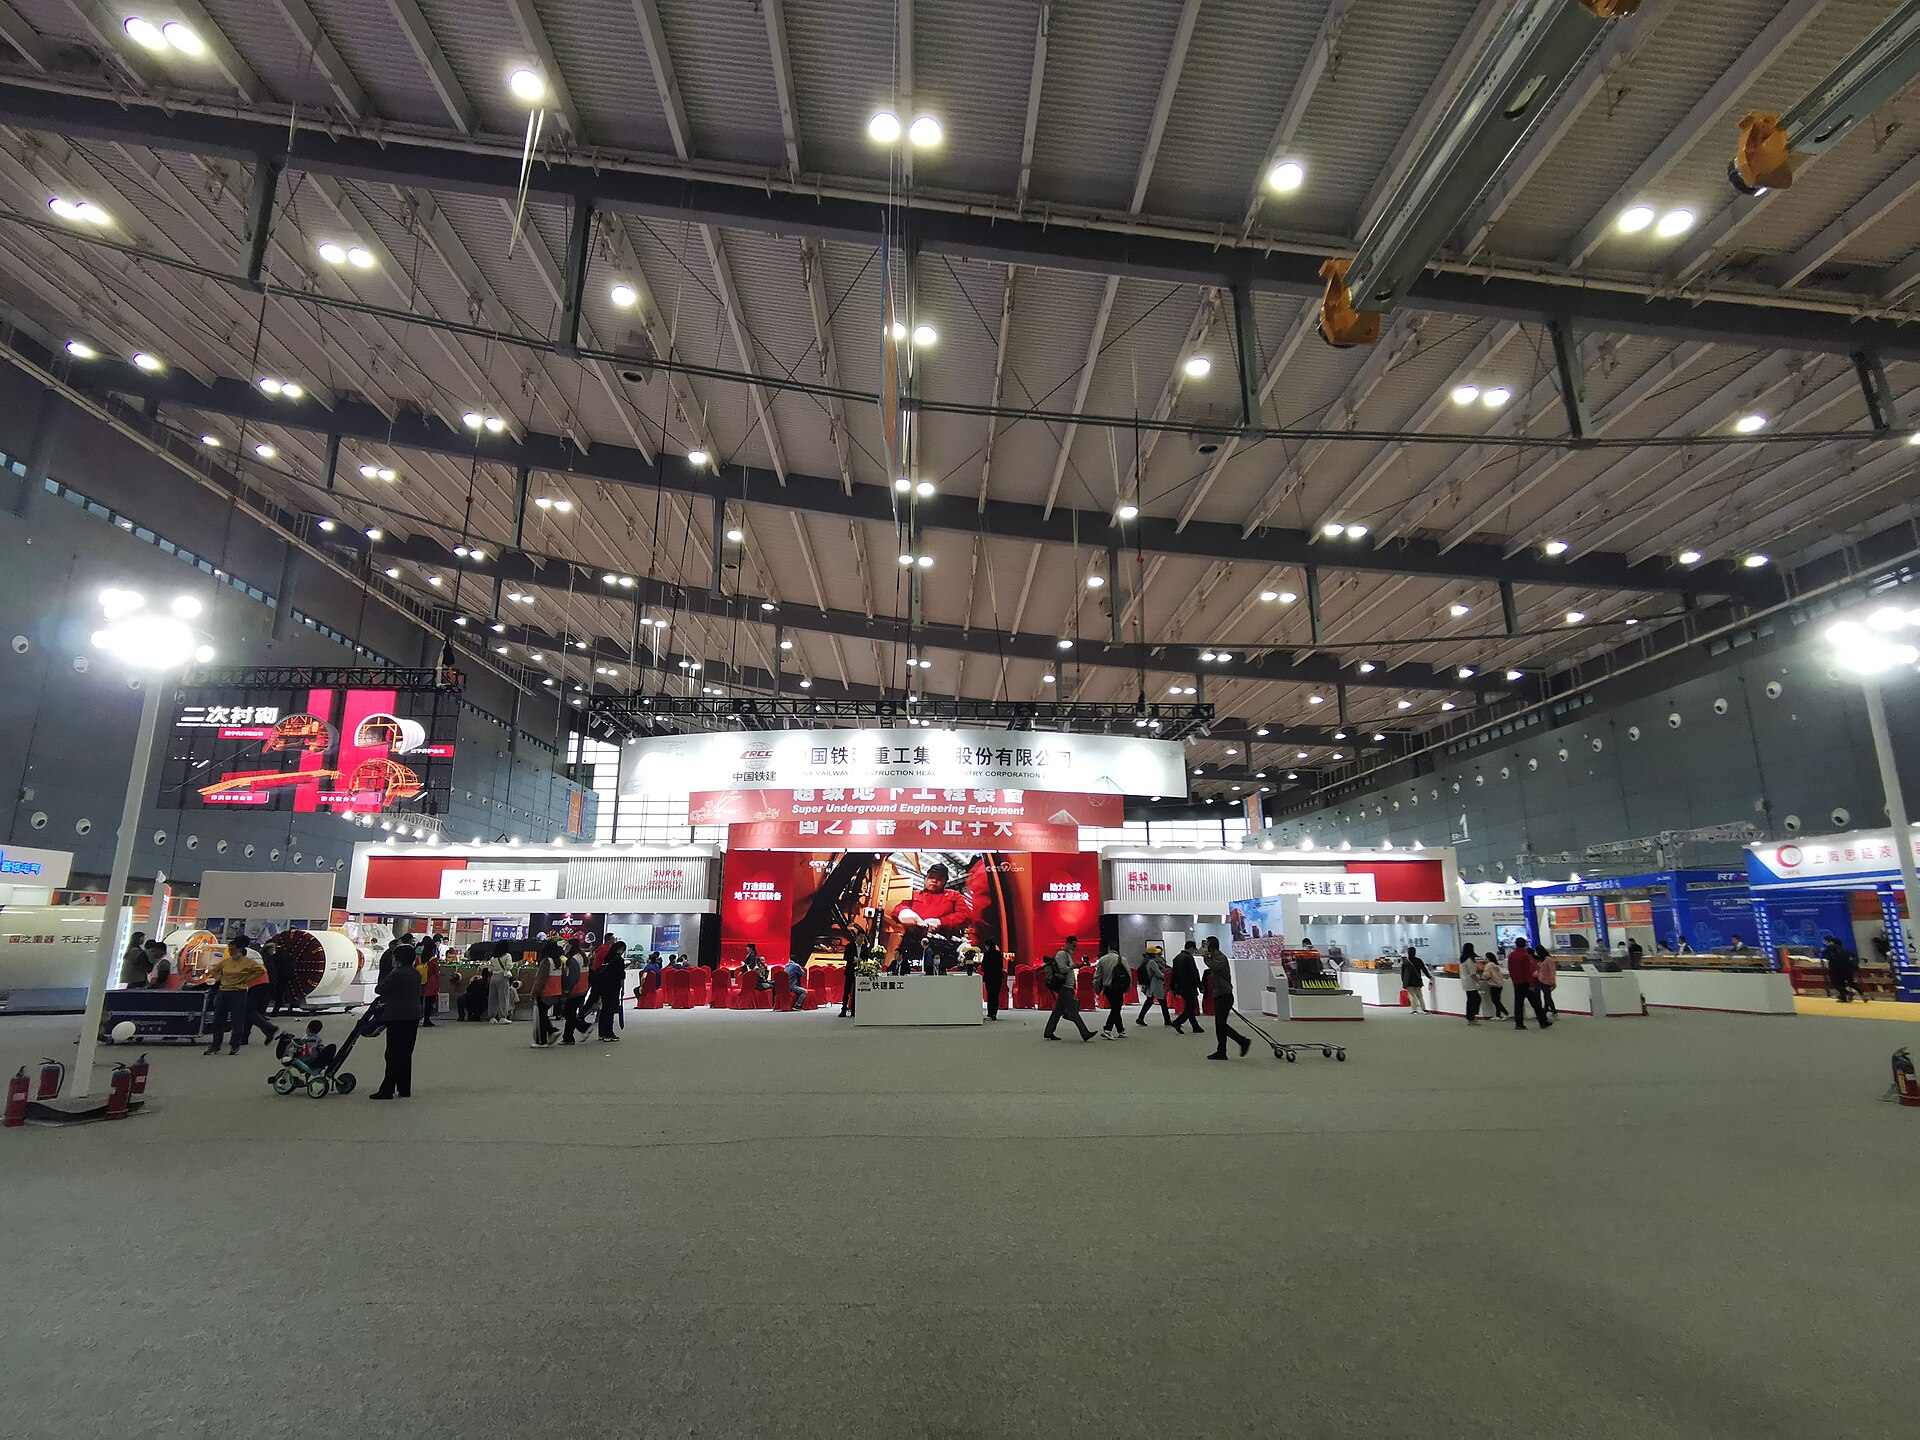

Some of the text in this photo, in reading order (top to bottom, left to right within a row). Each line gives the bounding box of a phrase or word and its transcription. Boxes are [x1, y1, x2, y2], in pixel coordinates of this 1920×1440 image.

[181, 706, 279, 724] 二次衬砌
[740, 750, 774, 760] CRCC
[732, 771, 776, 782] 中国铁建
[985, 771, 1041, 779] CORPORATION
[792, 803, 1025, 815] Super Underground Engineering Equipment
[654, 869, 683, 877] SUPER
[482, 878, 542, 893] 铁建重工
[742, 881, 775, 891] 打造超级
[1303, 881, 1361, 896] 铁建重工
[733, 890, 782, 901] 地下工程装备
[9, 935, 55, 944] 国之重器
[872, 981, 905, 990] 铁建重工
